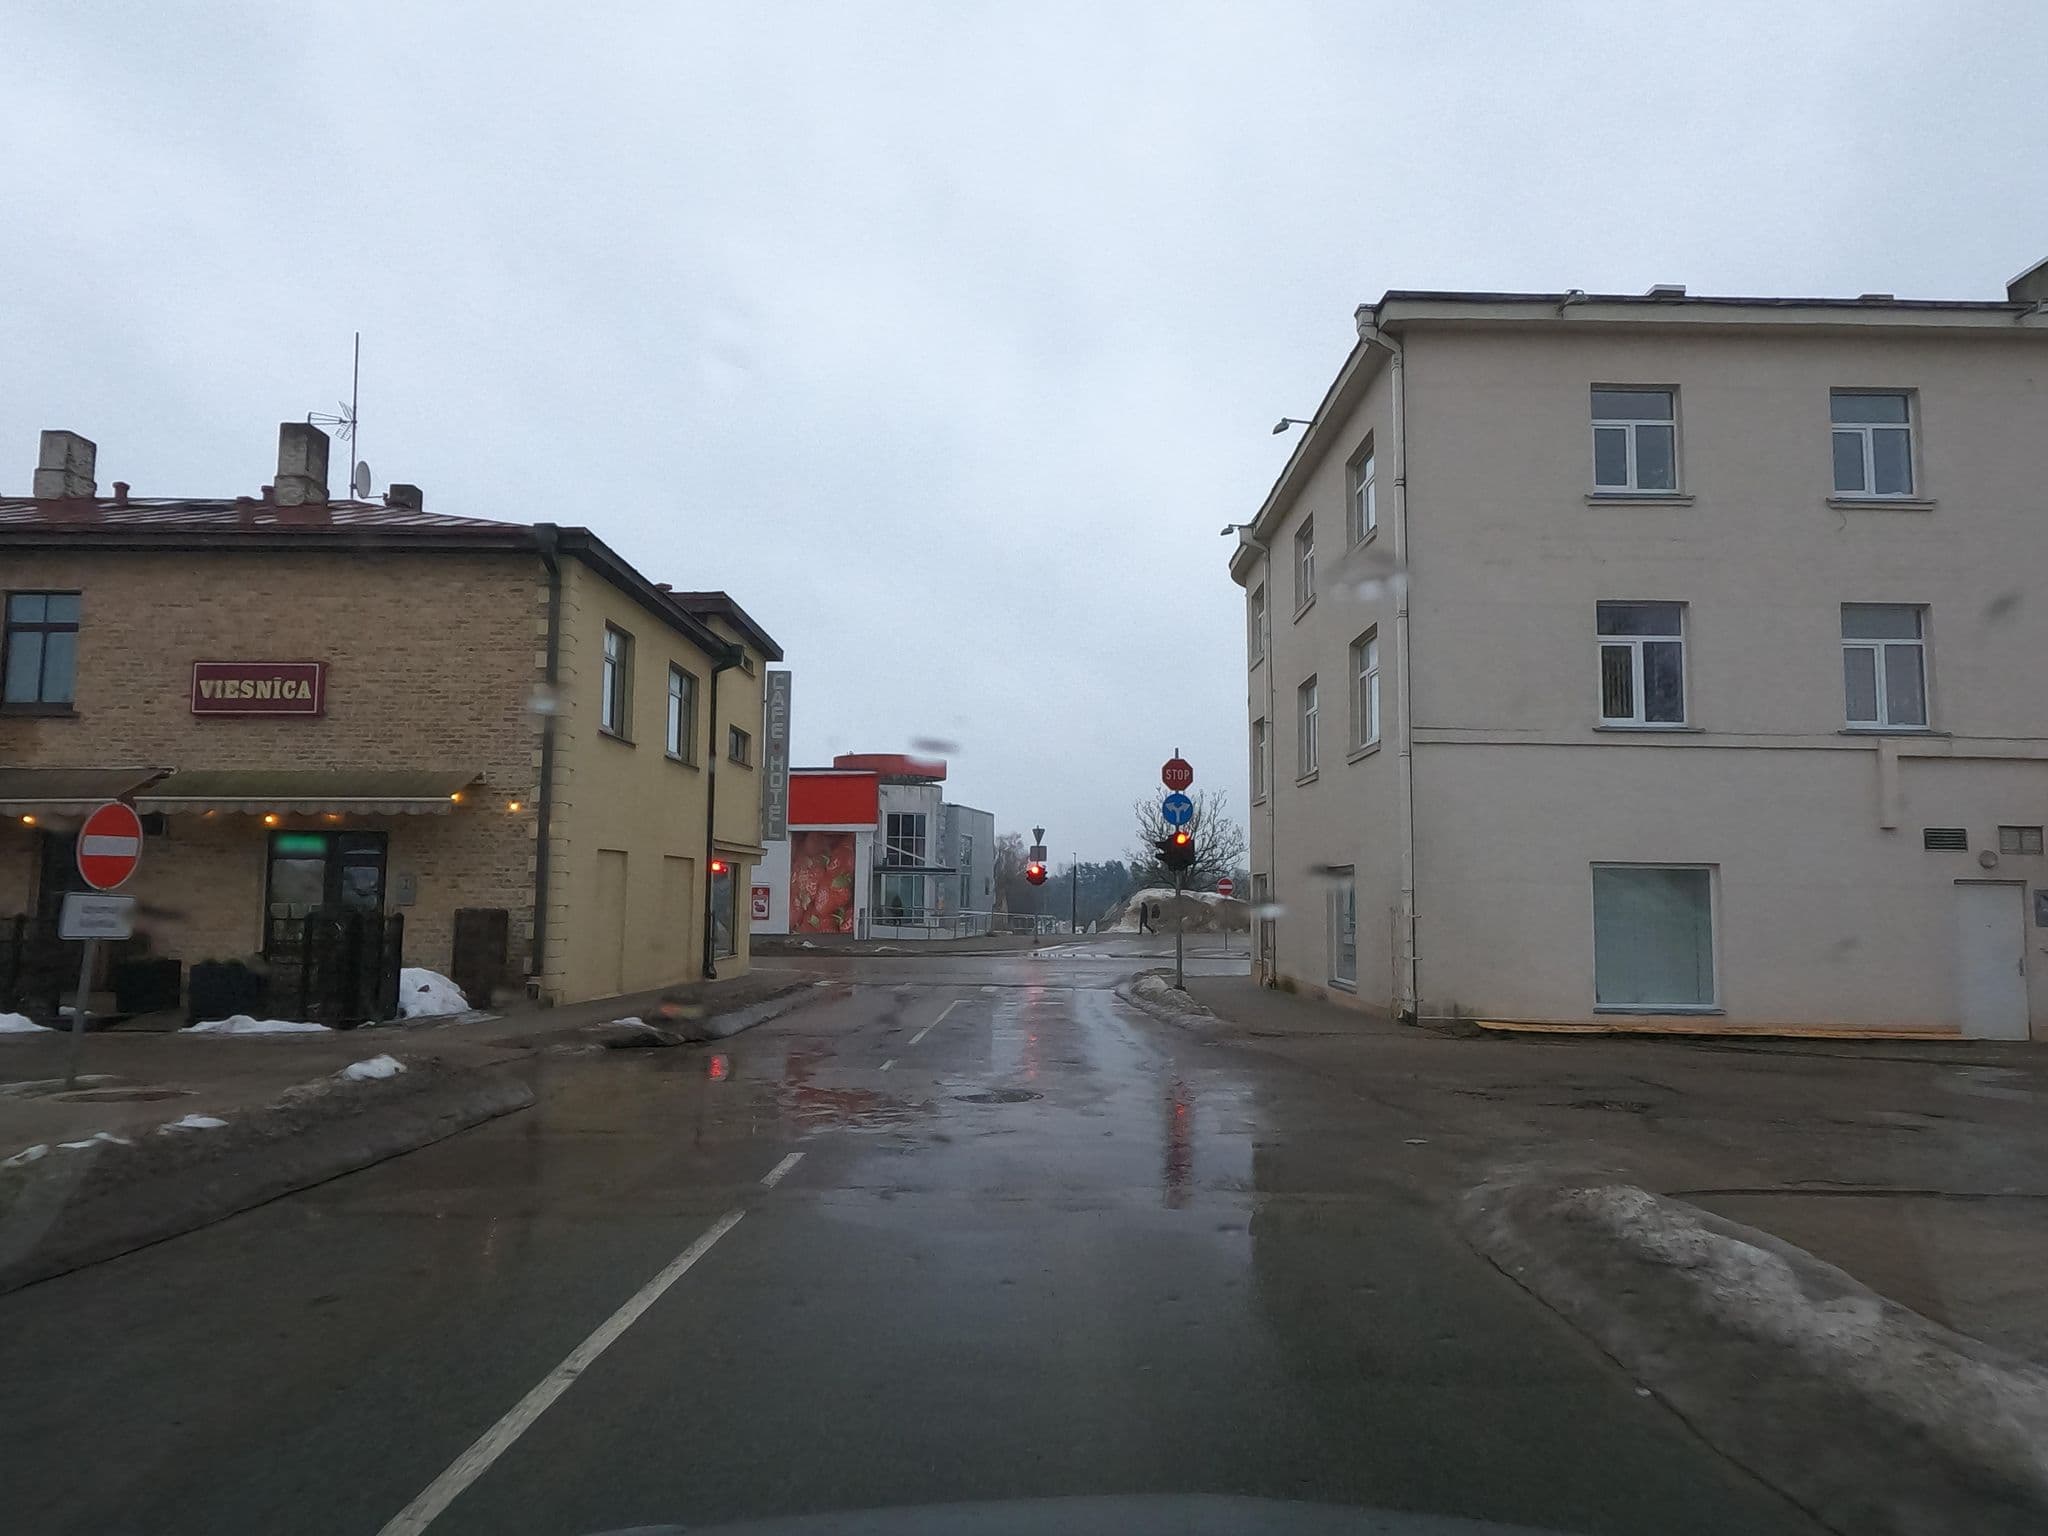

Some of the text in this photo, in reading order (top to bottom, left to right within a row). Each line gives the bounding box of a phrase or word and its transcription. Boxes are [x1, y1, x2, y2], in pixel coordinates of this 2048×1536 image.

[199, 676, 312, 699] VIESNĪCA
[768, 673, 785, 839] CAFE HOTEL
[1165, 769, 1190, 780] STOP
